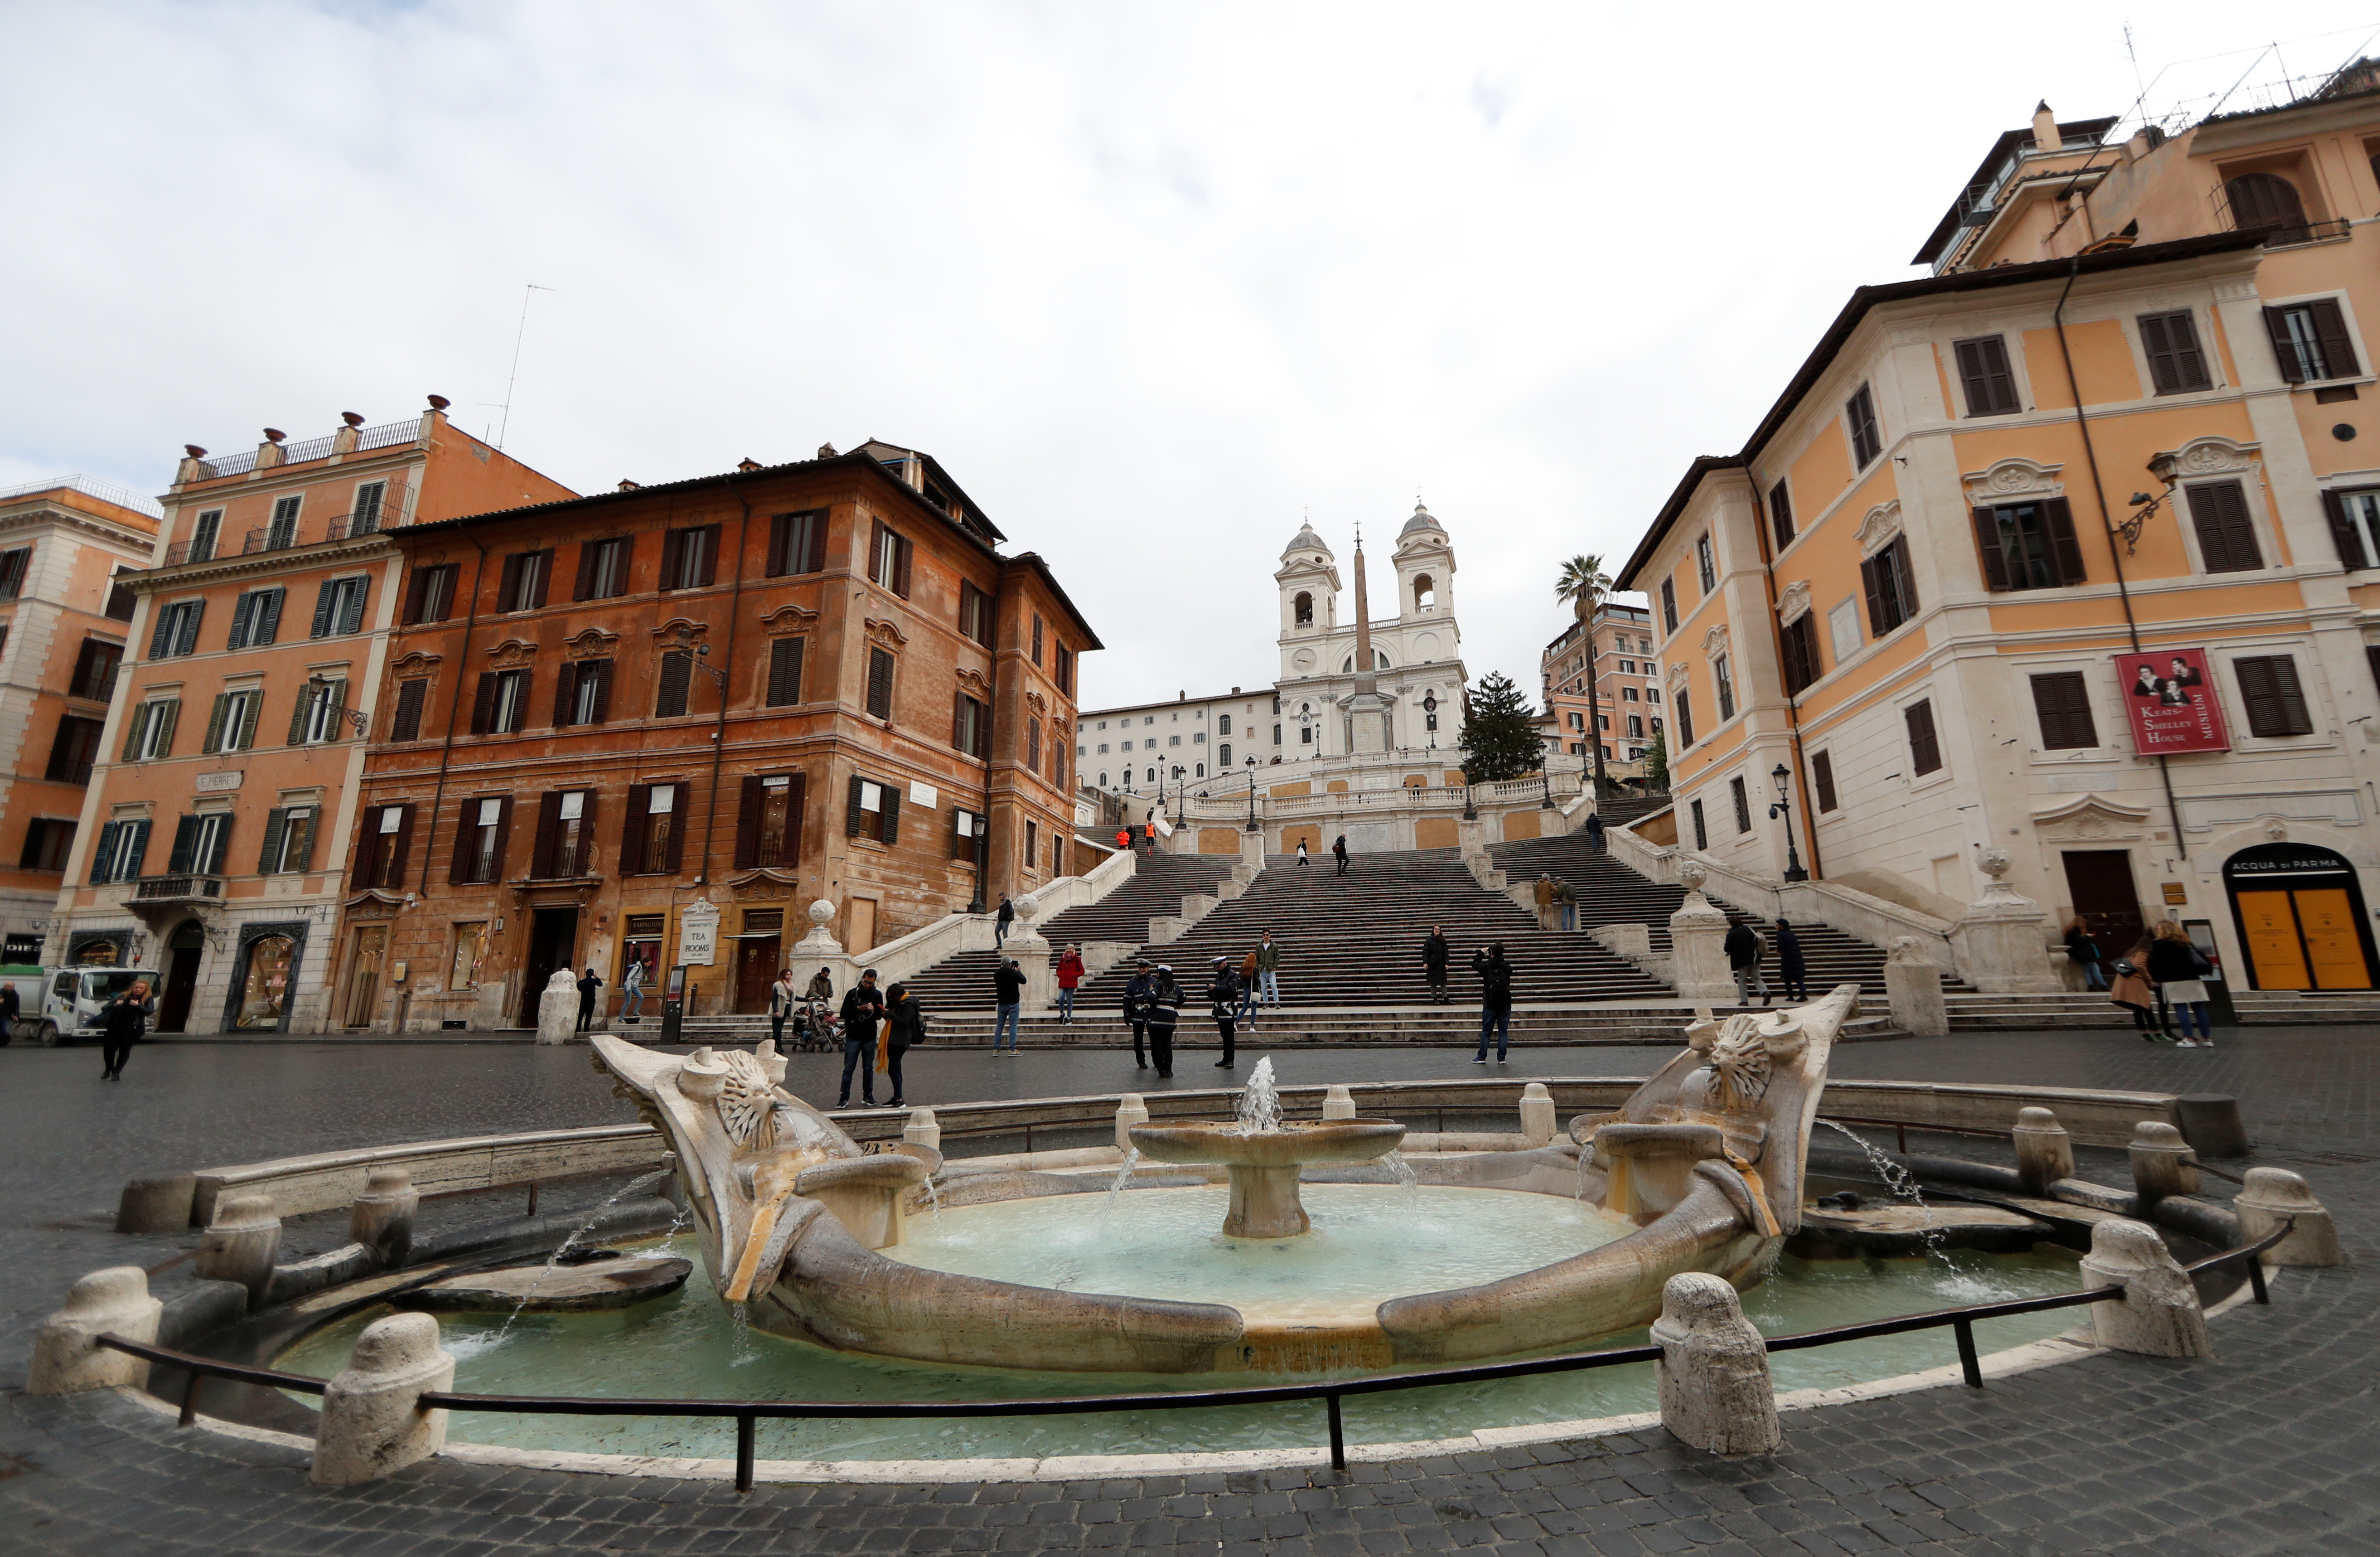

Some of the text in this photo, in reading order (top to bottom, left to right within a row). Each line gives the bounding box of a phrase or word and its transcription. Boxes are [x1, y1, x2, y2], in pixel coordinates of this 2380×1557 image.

[2140, 706, 2183, 718] KEATS-
[2192, 694, 2214, 739] MUSEUM
[2144, 719, 2192, 730] SHELLEY
[2147, 732, 2187, 743] HOUSE
[209, 775, 235, 786] PIERRET
[2293, 859, 2340, 868] PARMA
